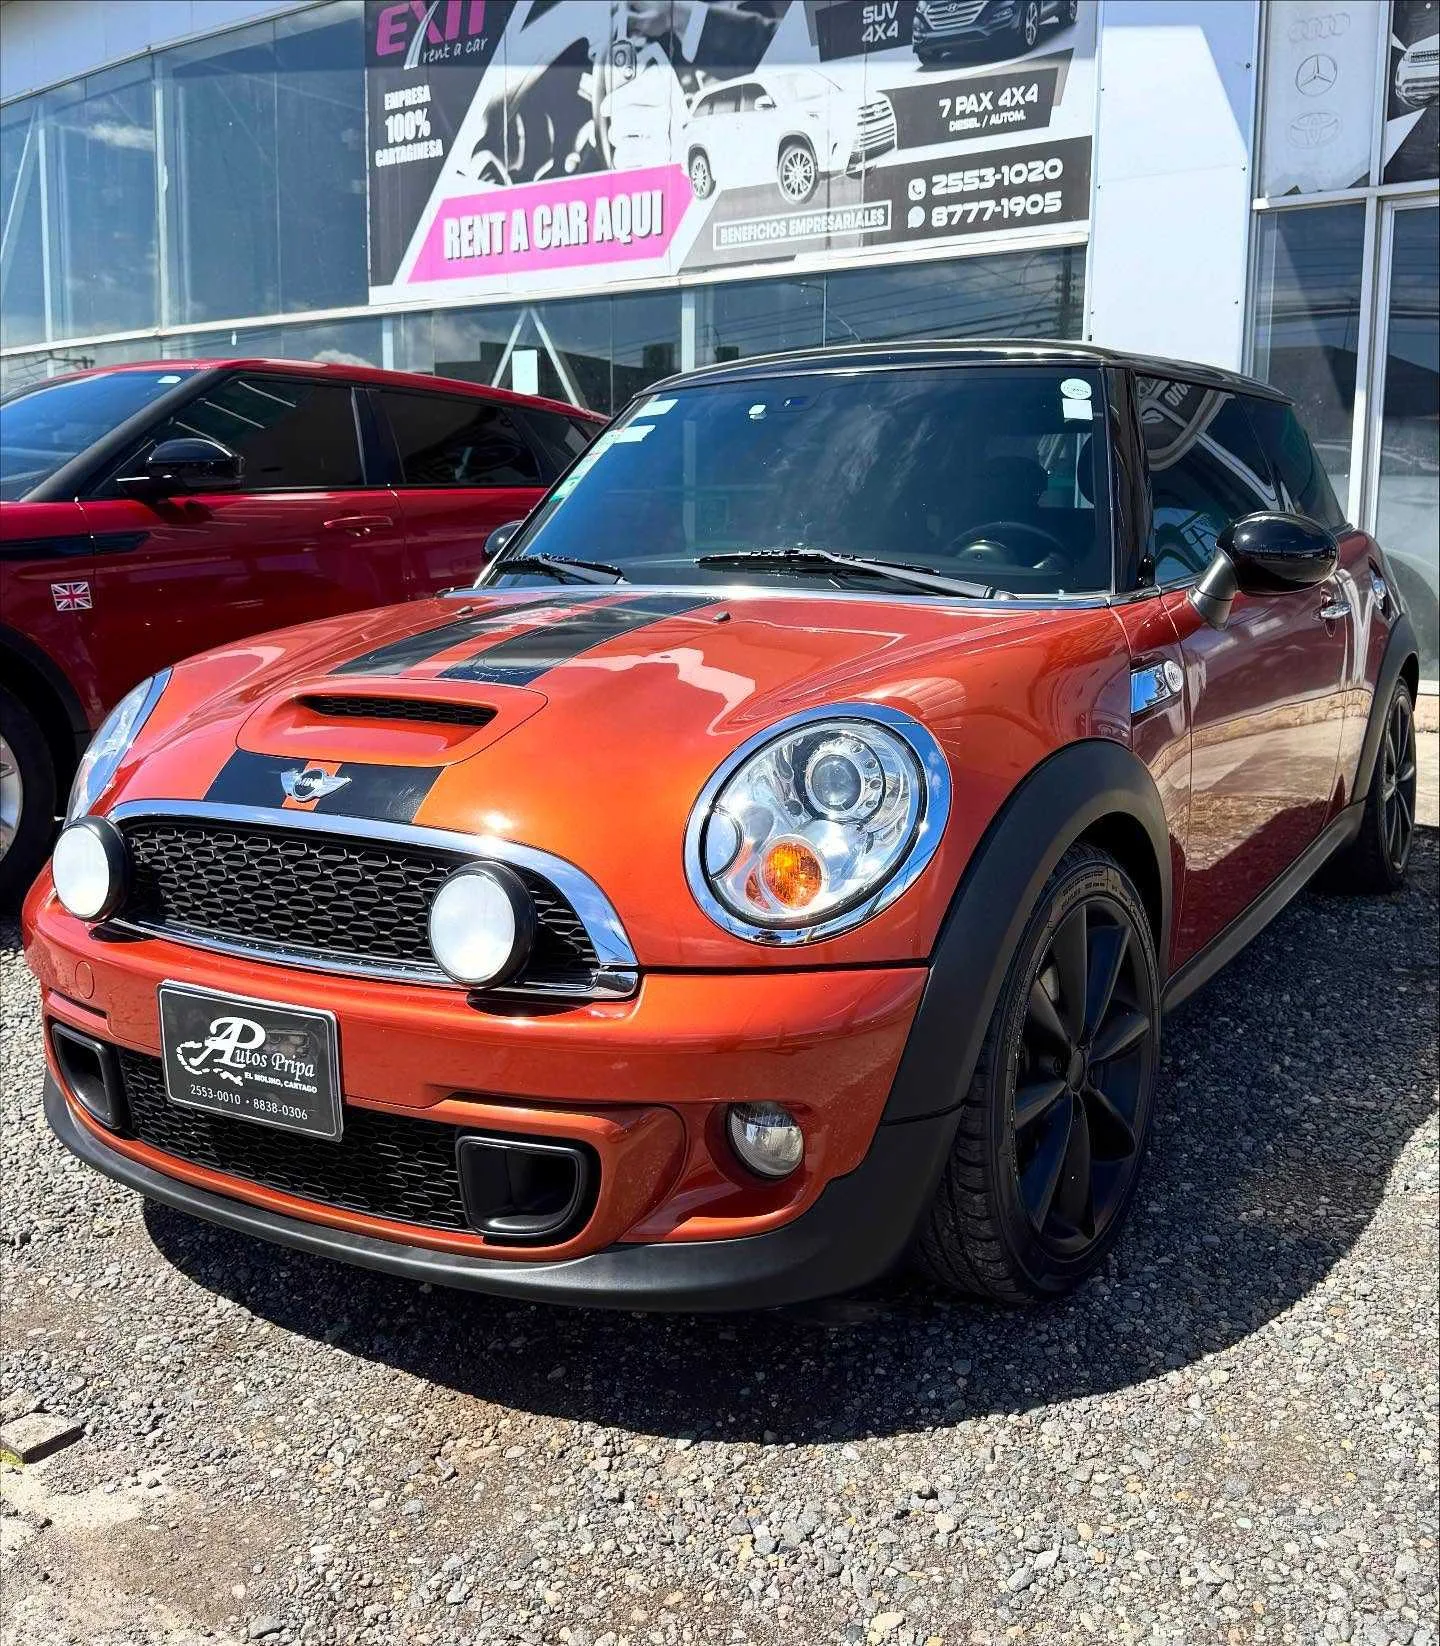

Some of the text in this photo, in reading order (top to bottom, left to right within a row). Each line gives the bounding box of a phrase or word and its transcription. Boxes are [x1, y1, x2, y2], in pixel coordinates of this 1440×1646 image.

[862, 2, 898, 26] SUV
[861, 21, 899, 43] 4X4
[423, 37, 488, 63] rent a car
[384, 84, 431, 111] EMPRESA
[938, 83, 1039, 118] 7 PAX 4X4
[384, 107, 431, 144] 100%
[989, 109, 1026, 126] AUTOM.
[931, 157, 1064, 196] 2553-1020
[931, 190, 1063, 228] 8777-1905
[443, 190, 664, 260] RENT A CAR AQUI
[720, 207, 885, 244] BENEFICIOS EMPRESARIALES
[244, 1072, 253, 1080] EL
[271, 1053, 316, 1081] Pripa
[190, 1084, 308, 1120] 2553-0010 8838-0306
